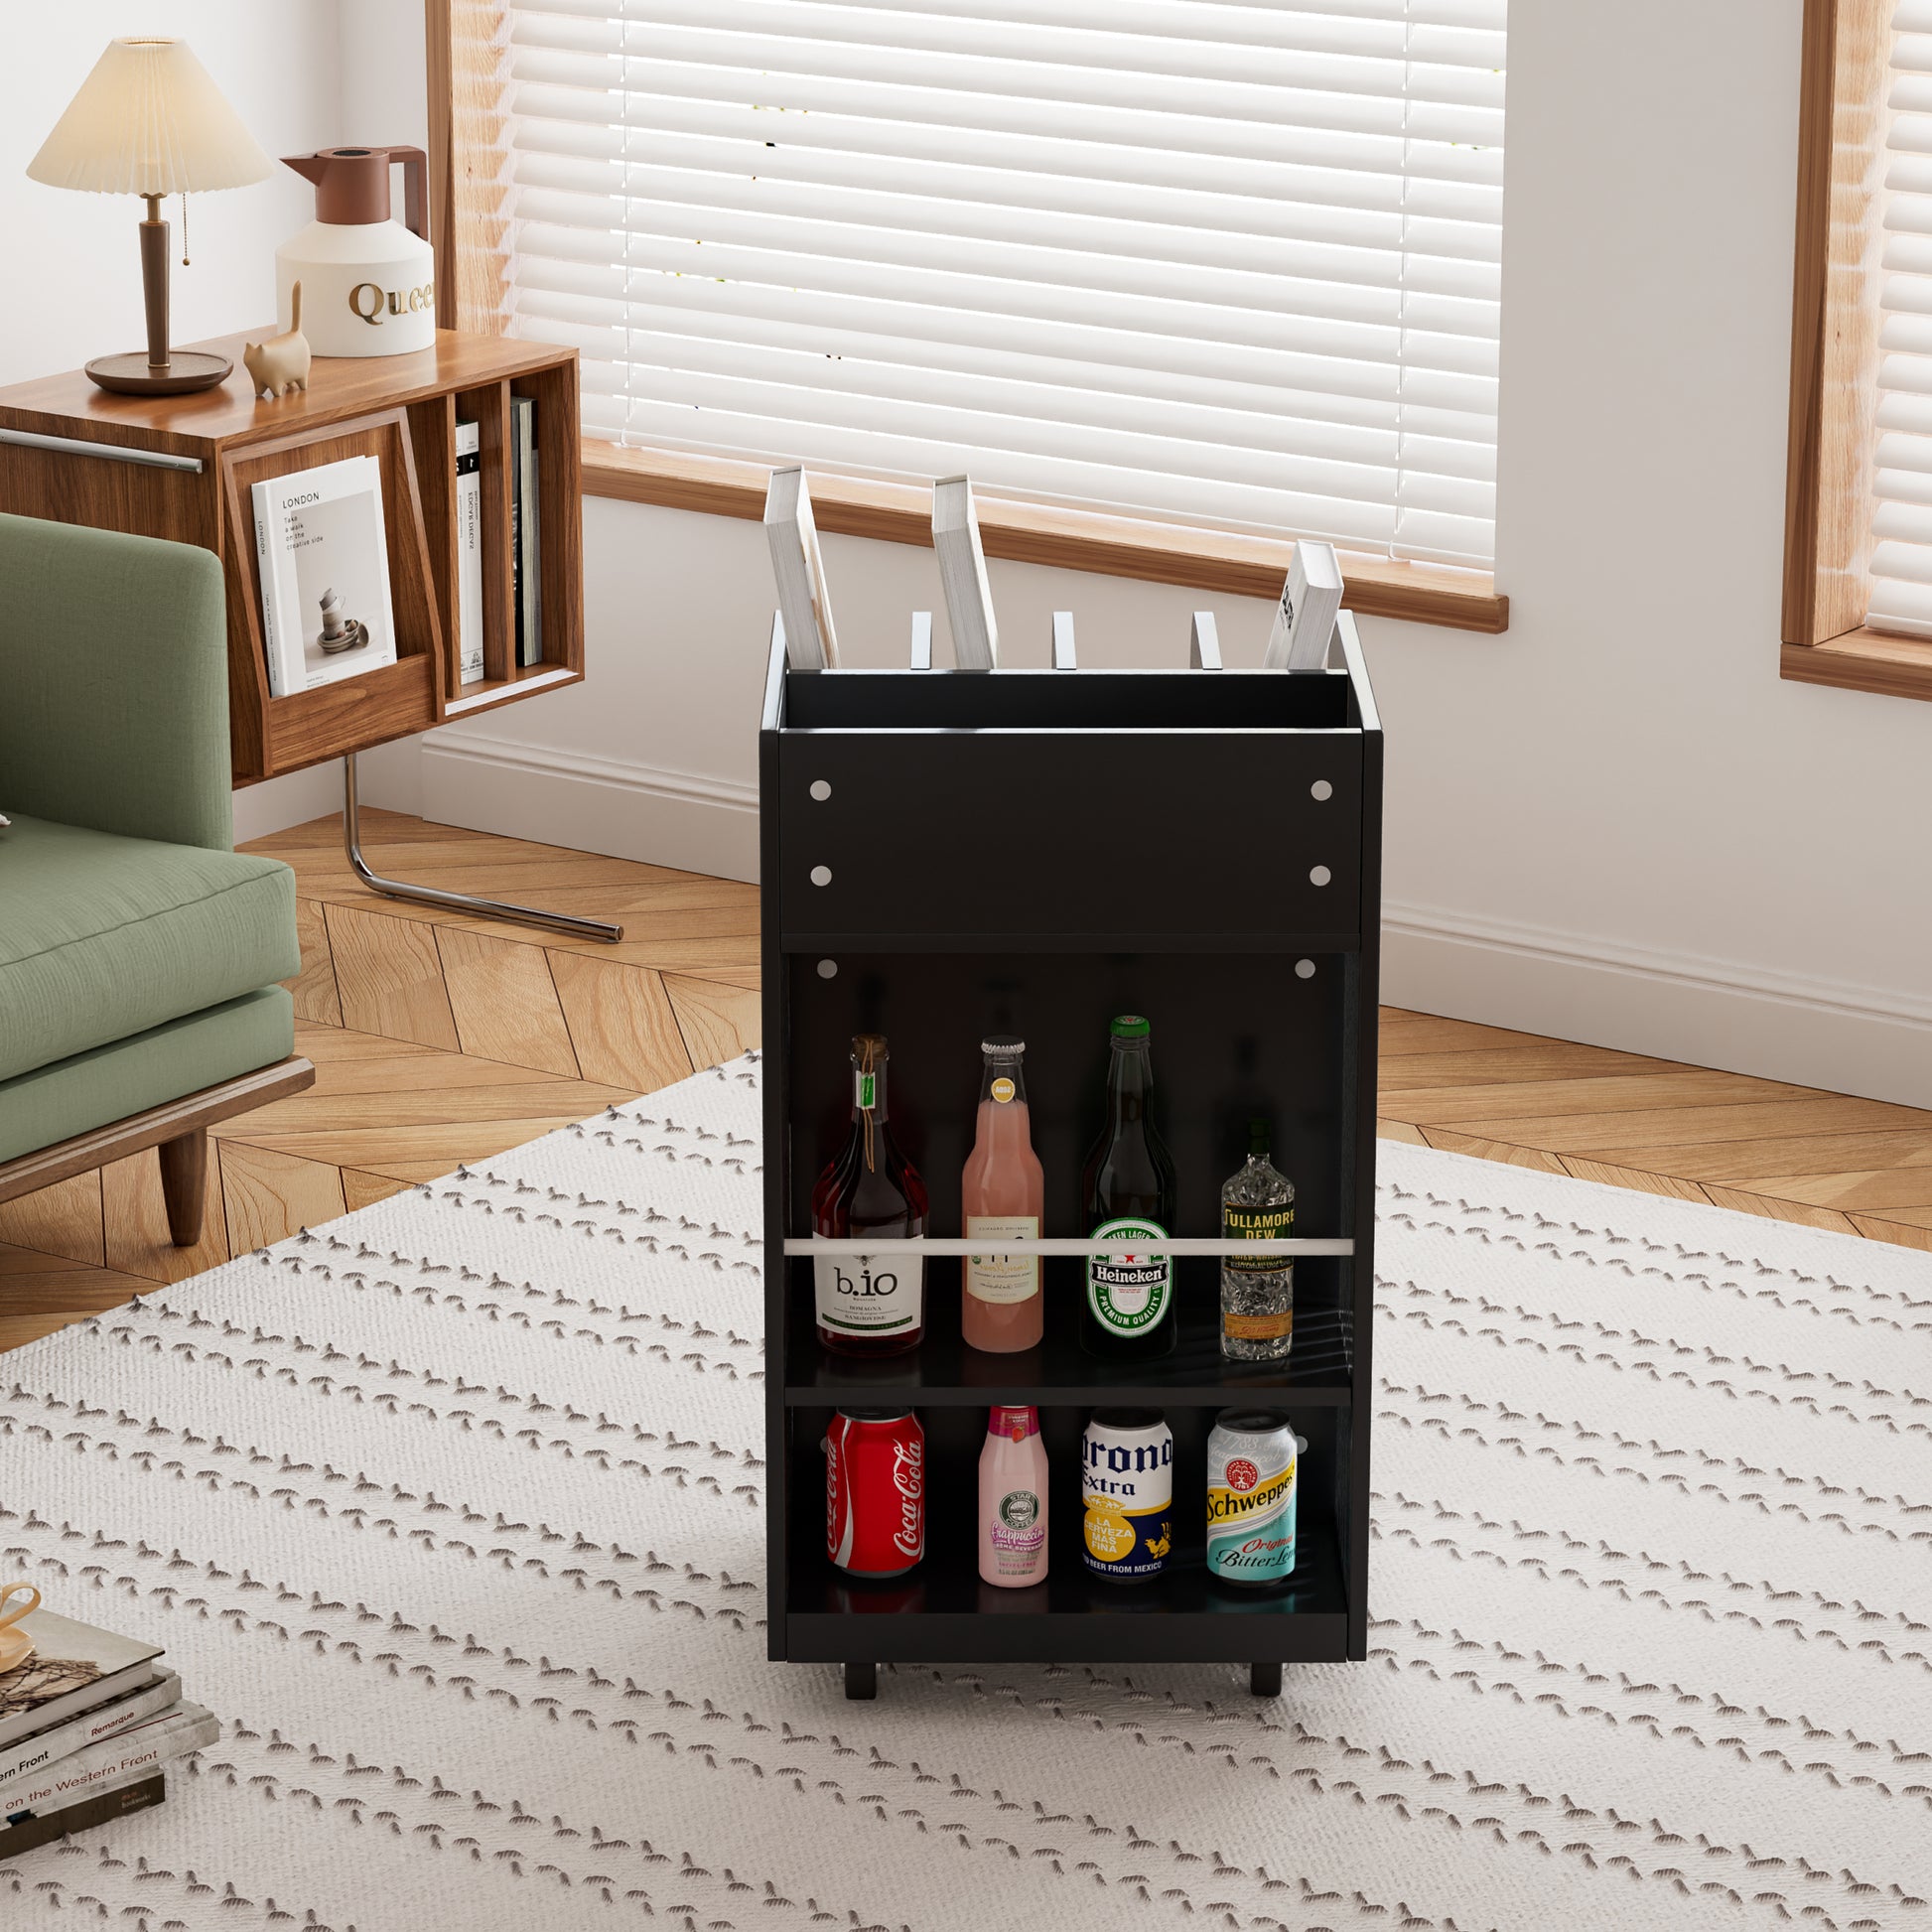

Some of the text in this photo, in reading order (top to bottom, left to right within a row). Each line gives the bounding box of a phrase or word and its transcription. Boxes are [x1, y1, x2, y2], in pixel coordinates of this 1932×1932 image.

[348, 283, 435, 326] Quee
[282, 491, 320, 509] LONDON
[284, 515, 298, 524] Take
[257, 520, 266, 556] LONDON
[286, 539, 310, 551] creative
[1224, 1208, 1295, 1228] TULLAMORE
[833, 1267, 897, 1297] b.io
[1096, 1266, 1163, 1284] Heineken
[1099, 1296, 1130, 1325] PREMIUM
[1132, 1296, 1161, 1325] QUALITY
[893, 1439, 922, 1557] Coca-Cola
[1206, 1473, 1293, 1522] Schweppes
[991, 1521, 1044, 1545] Frappuccin
[1096, 1517, 1110, 1527] LA
[1091, 1540, 1118, 1554] FINA
[1215, 1549, 1275, 1567] Bitter
[1090, 1559, 1163, 1574] BEER FROM MEXICO
[91, 1712, 135, 1736] Remarque
[19, 1750, 49, 1772] Front
[5, 1749, 158, 1810] on the Western Front
